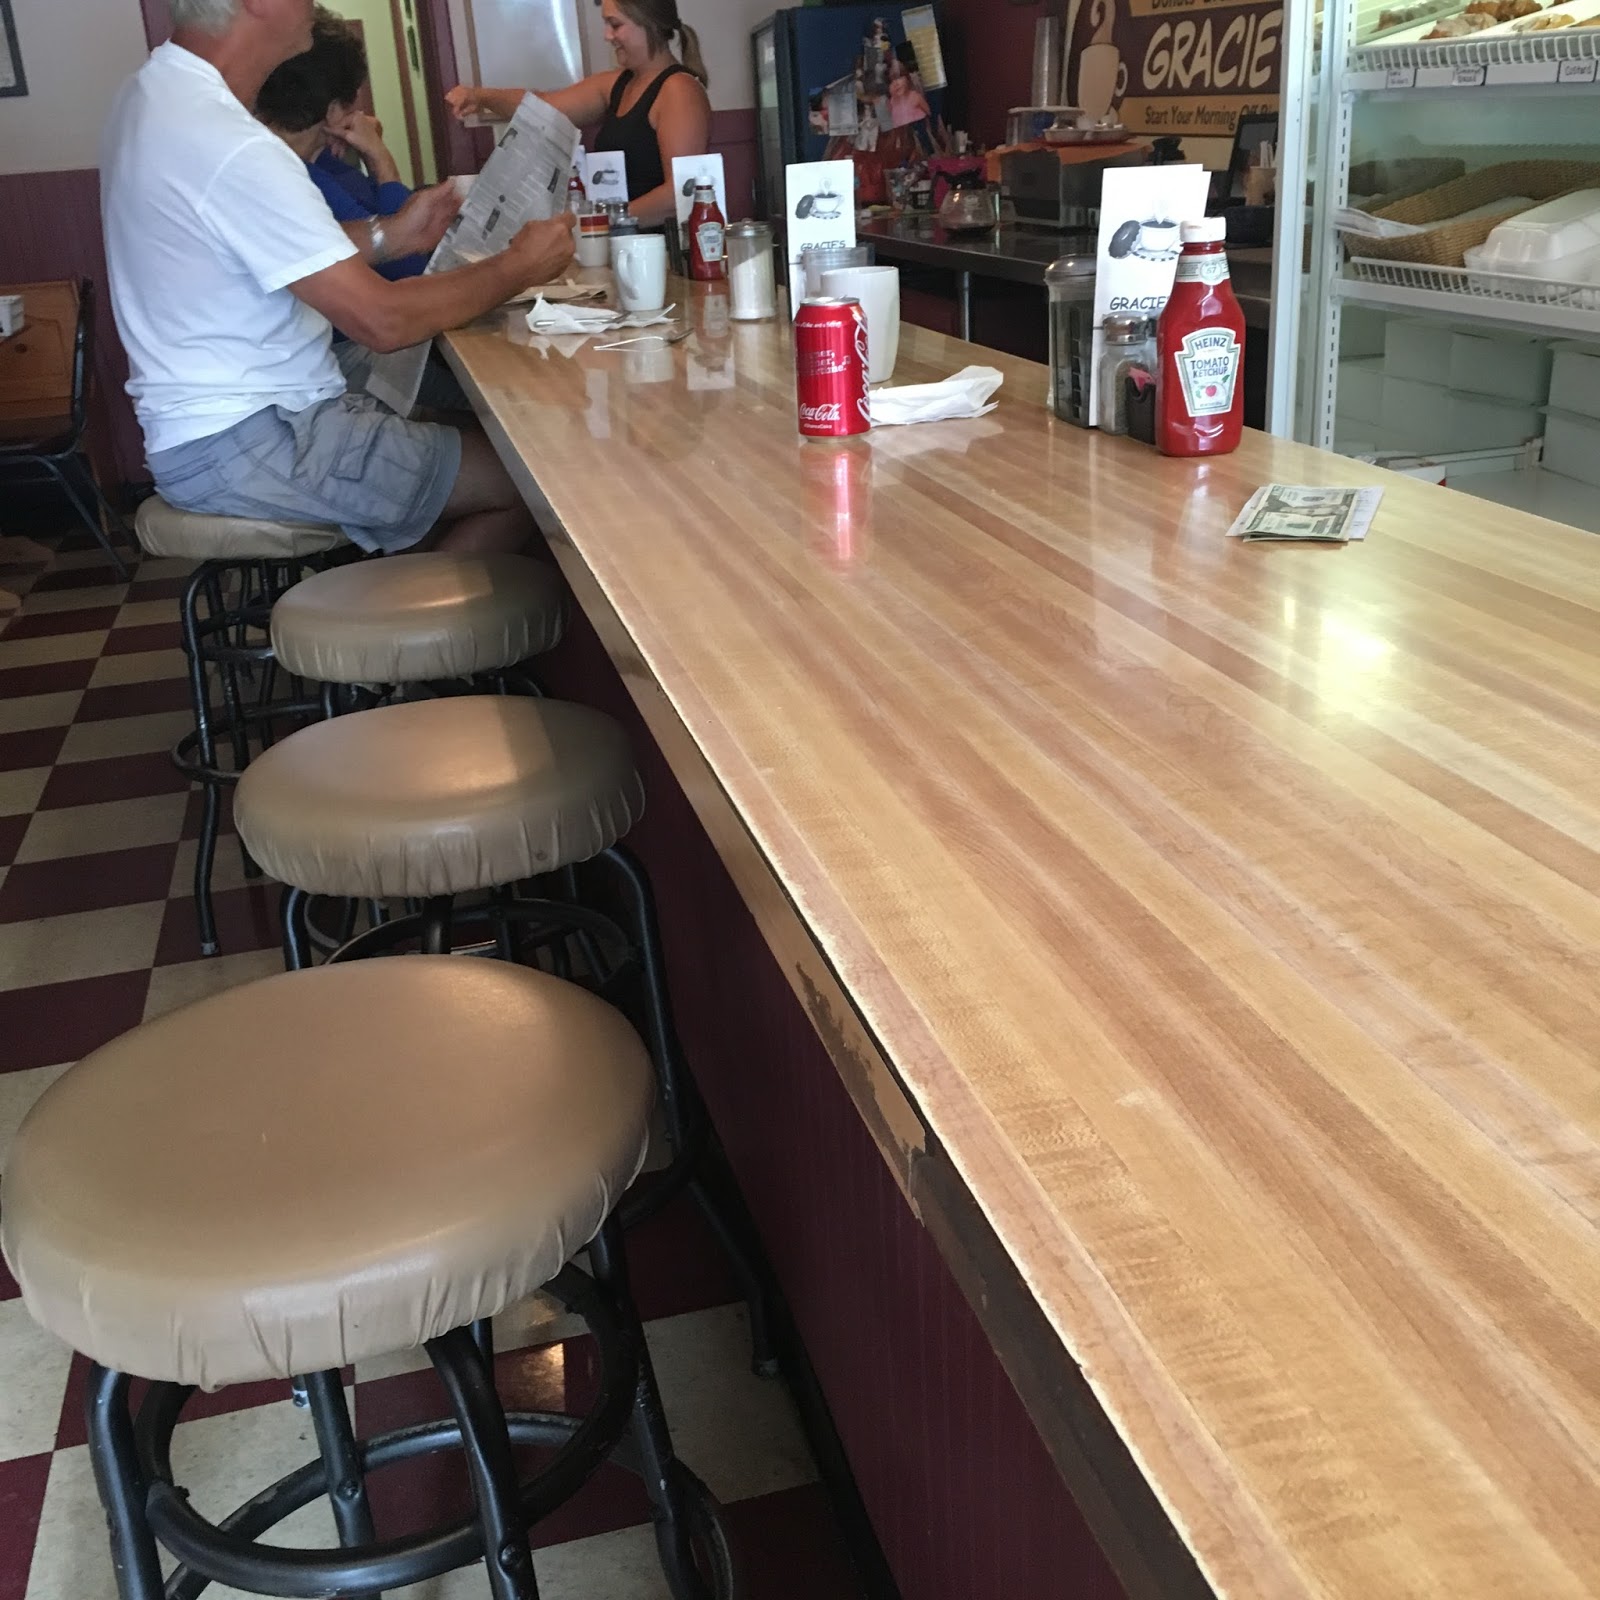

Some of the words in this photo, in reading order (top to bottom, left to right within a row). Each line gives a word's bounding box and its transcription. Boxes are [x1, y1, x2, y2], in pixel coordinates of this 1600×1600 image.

[1143, 9, 1283, 90] GRACIE
[1145, 105, 1168, 125] Start
[1171, 105, 1193, 124] Your
[1194, 104, 1237, 131] Morning
[1109, 296, 1167, 311] GRACIE
[1194, 337, 1227, 350] HEINZ
[1190, 356, 1230, 371] TOMATO
[1193, 367, 1228, 378] KETCHUP
